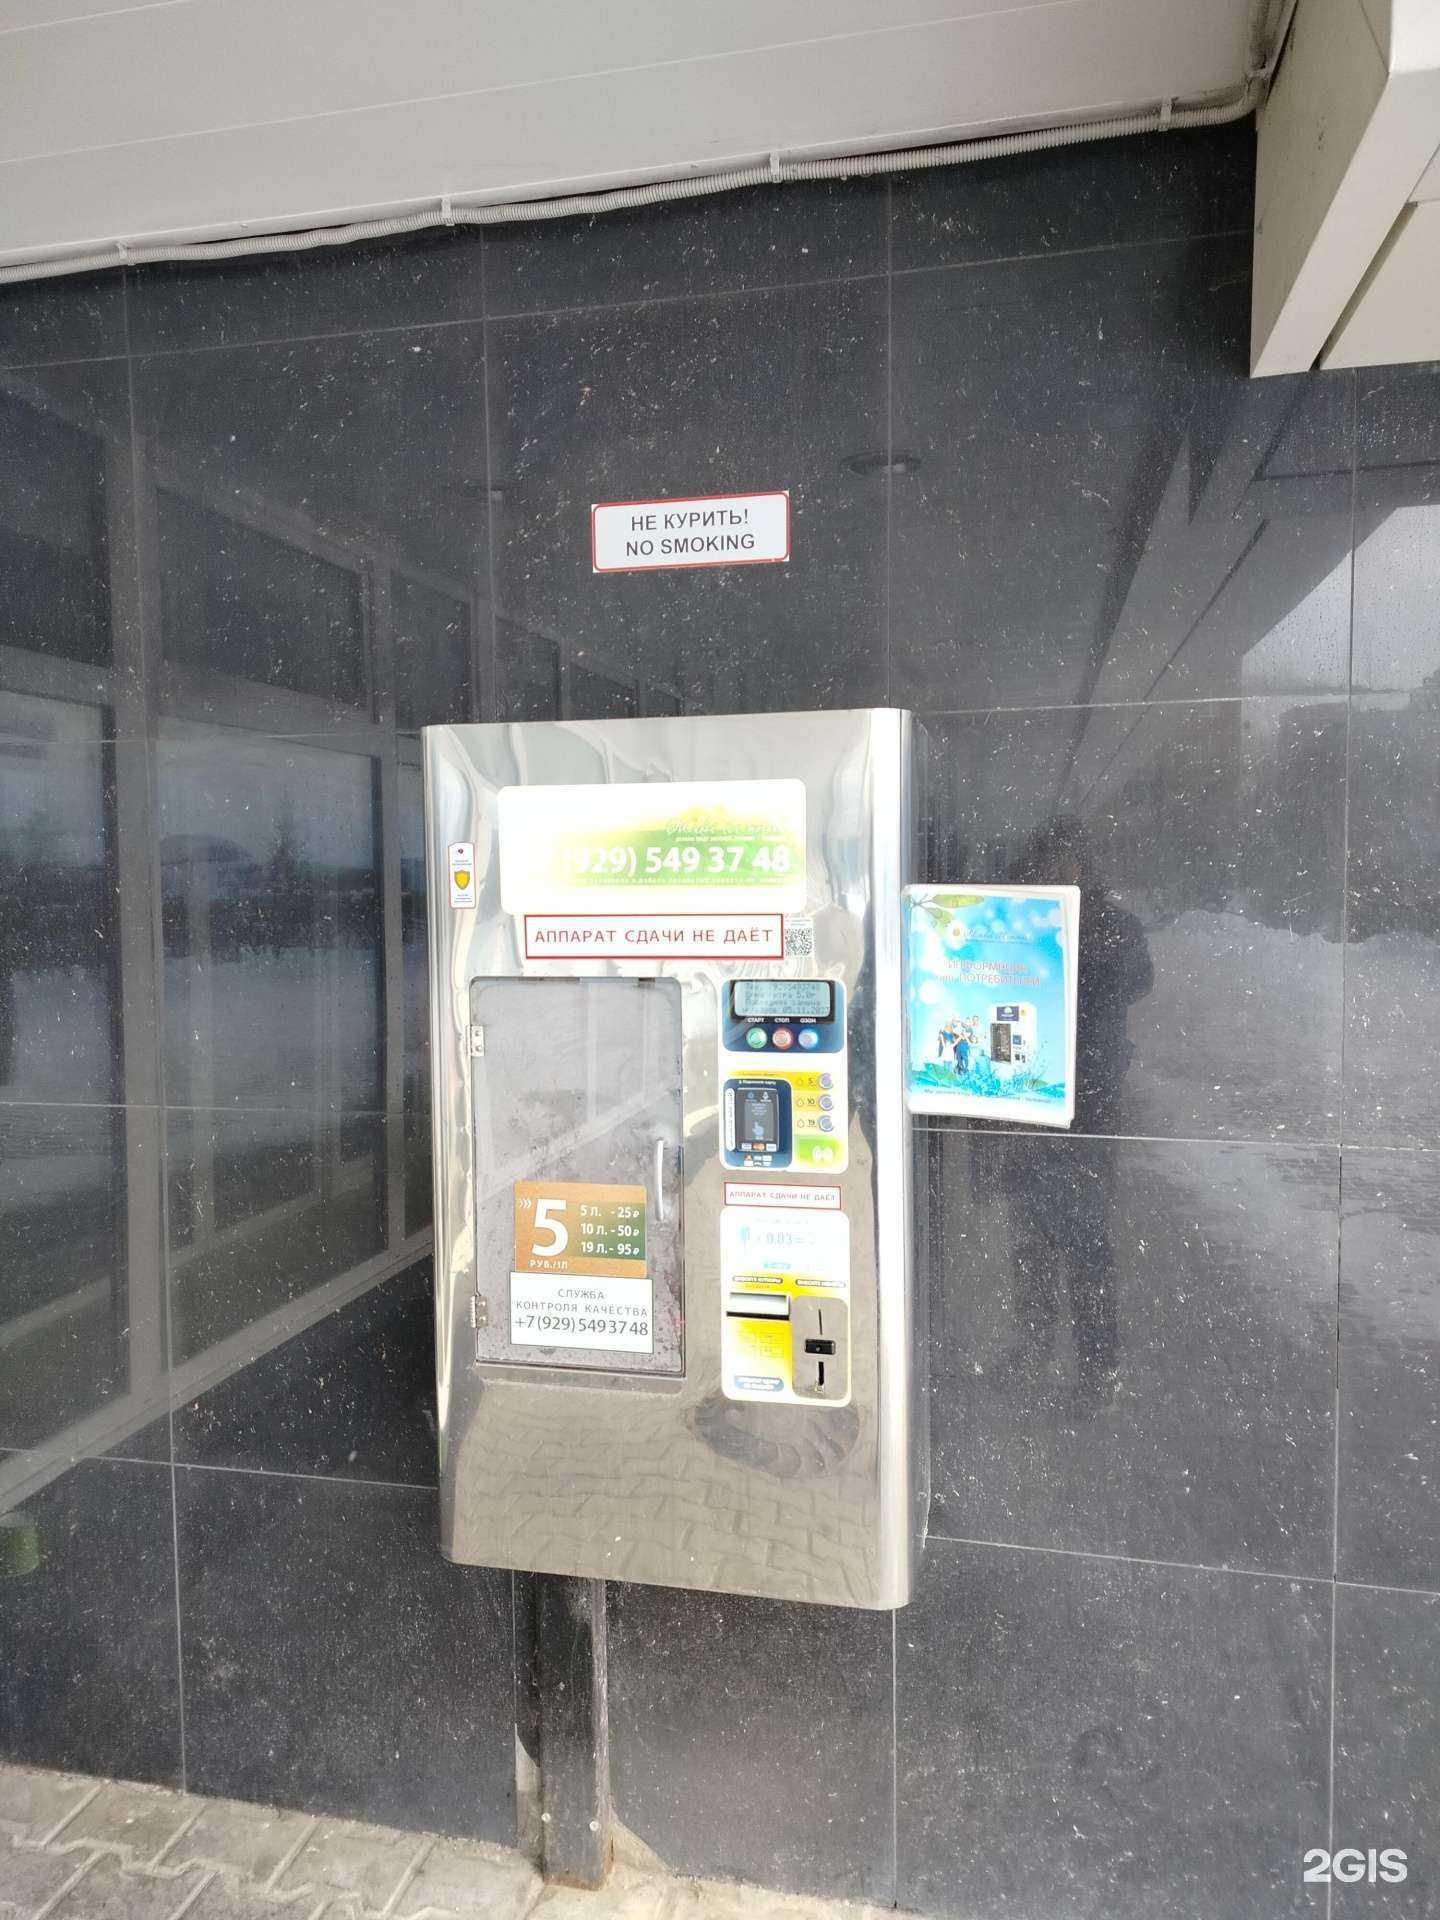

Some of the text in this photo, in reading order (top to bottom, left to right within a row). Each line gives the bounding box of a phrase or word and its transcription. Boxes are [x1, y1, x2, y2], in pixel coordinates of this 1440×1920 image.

[631, 508, 749, 531] НЕ КУРИТЬ!
[626, 533, 755, 556] NO SMOKING
[646, 846, 700, 874] 549
[708, 846, 745, 874] 37
[751, 844, 792, 873] 48
[535, 926, 773, 945] АППАРАТ СДАЧИ НЕ ДАЁТ
[729, 1191, 766, 1199] АППАРАТ
[769, 1192, 798, 1200] СДАЧИ
[800, 1193, 811, 1201] НЕ
[580, 1204, 589, 1217] 5
[532, 1199, 569, 1257] 5
[580, 1222, 594, 1235] 10
[581, 1241, 594, 1253] 19
[558, 1288, 606, 1300] СЛУЖБА
[516, 1301, 648, 1317] КОНТРОЛЯ КАЧЕСТВА
